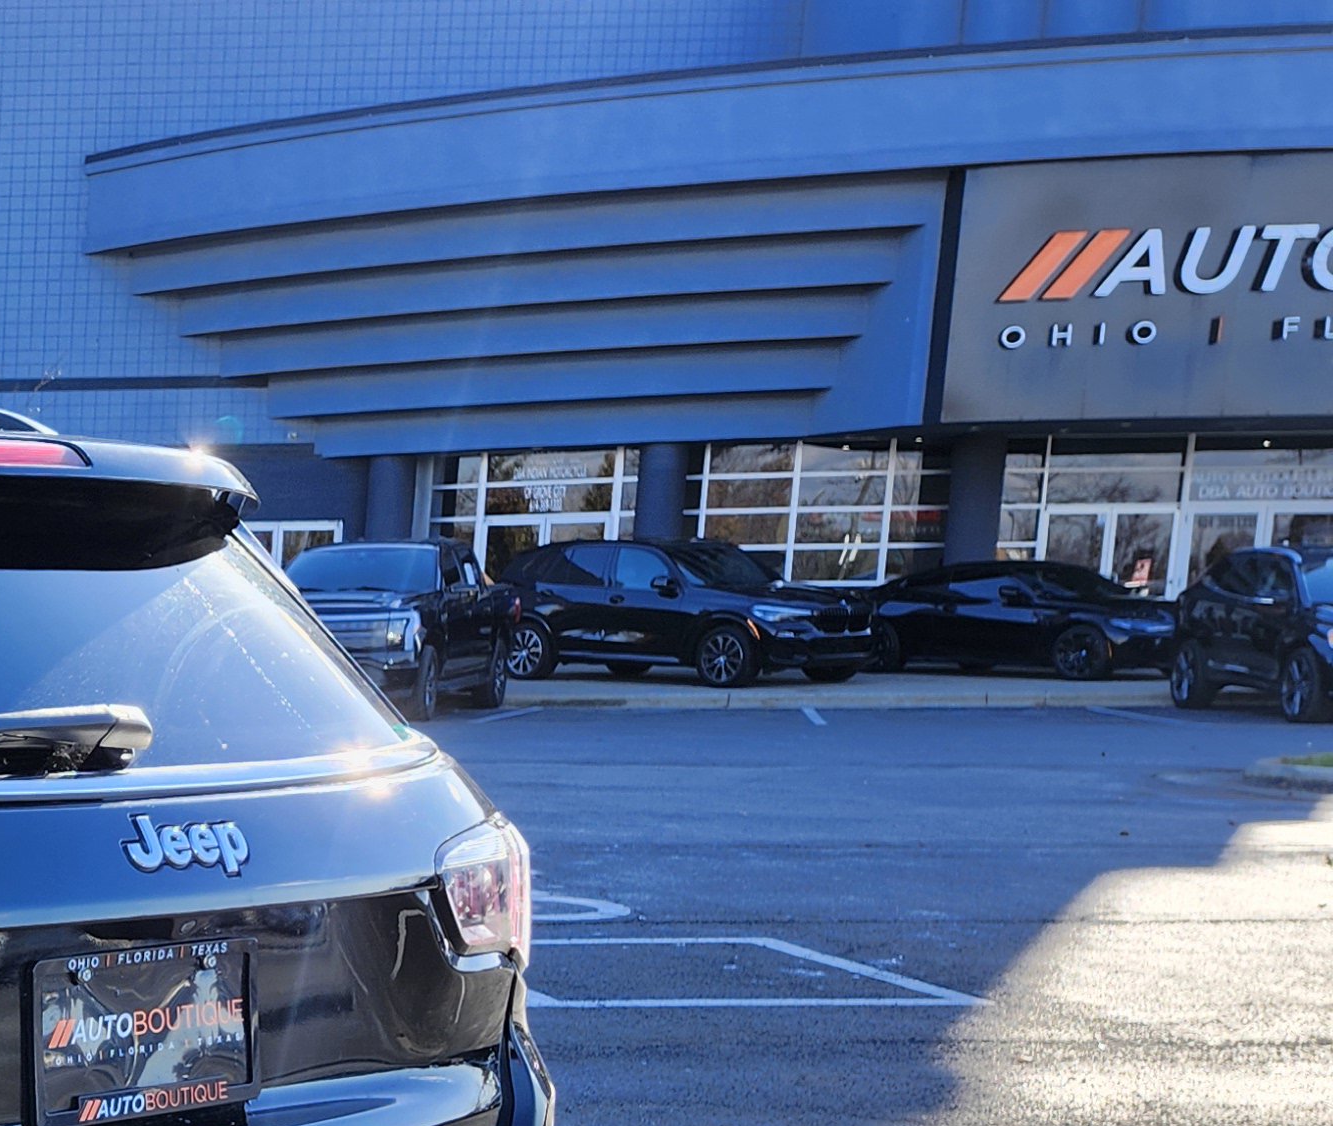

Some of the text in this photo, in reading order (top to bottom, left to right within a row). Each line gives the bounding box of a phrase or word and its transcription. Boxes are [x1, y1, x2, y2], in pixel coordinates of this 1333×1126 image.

[1094, 223, 1333, 297] AUT
[1000, 319, 1157, 349] OHIO
[121, 813, 250, 877] Jeep
[68, 942, 229, 971] OHIO FLORIDA TEXAS
[71, 998, 245, 1045] AUTOBOUTIQUE
[54, 1032, 243, 1066] OHIO FLORIDA TEXAS
[96, 1080, 230, 1120] AUTOBOUTIQUE
